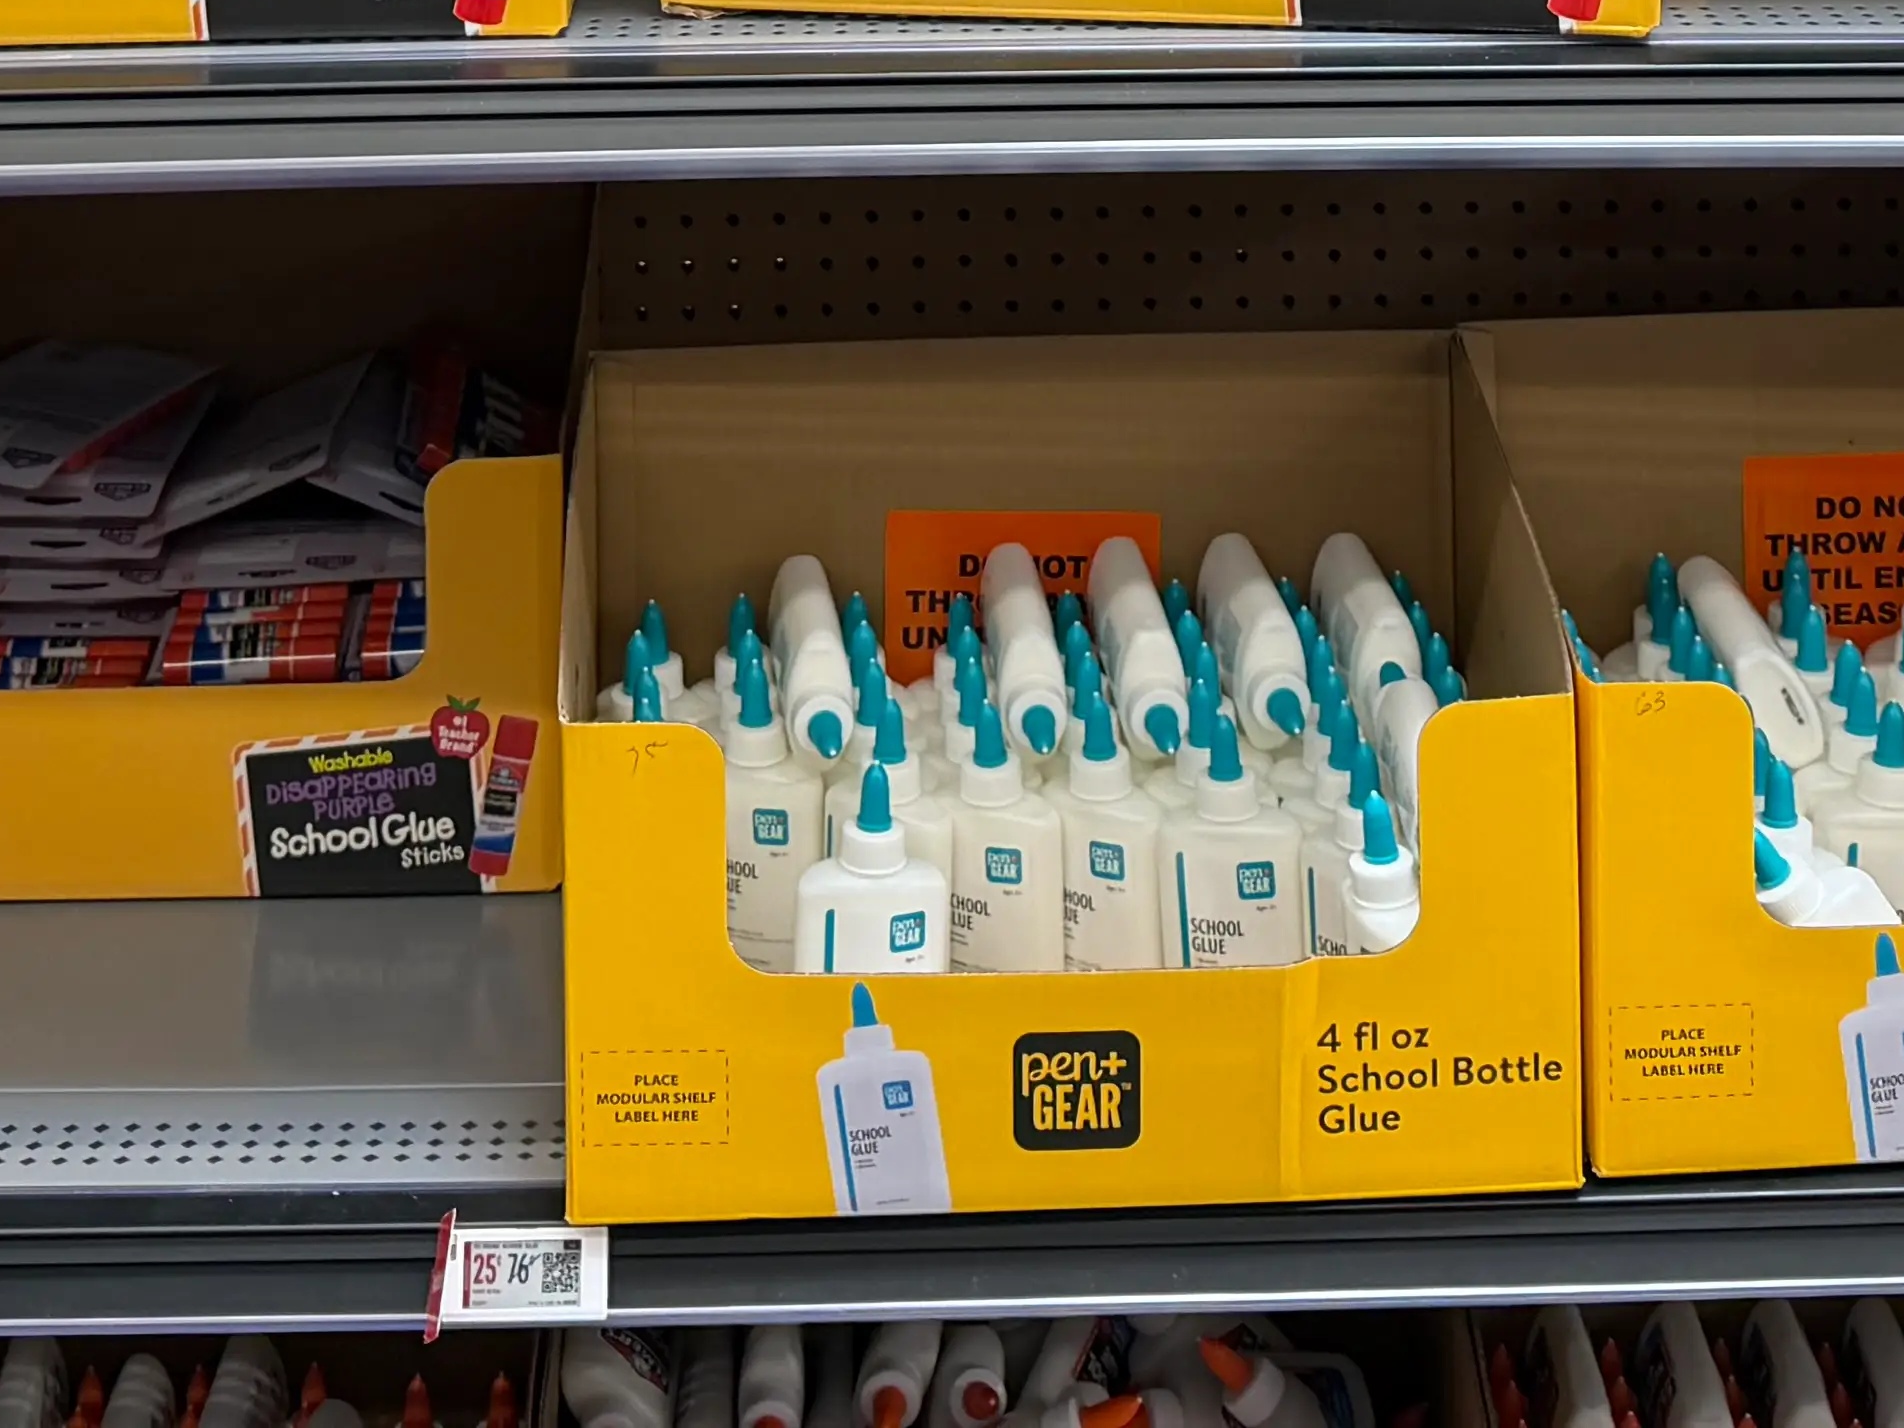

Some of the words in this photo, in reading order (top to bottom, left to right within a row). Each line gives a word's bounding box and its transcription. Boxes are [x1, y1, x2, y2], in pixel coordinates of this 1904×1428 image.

[1815, 494, 1861, 520] DO
[1765, 530, 1889, 556] THROW
[309, 748, 393, 773] Washable
[269, 816, 379, 860] School
[381, 812, 455, 848] Glue
[400, 842, 464, 870] Sticks
[1190, 918, 1245, 938] SCHOOL
[1190, 935, 1227, 955] GLUE
[633, 1074, 679, 1087] PLACE
[1316, 1061, 1439, 1096] School
[1452, 1051, 1562, 1091] Bottle
[1033, 1082, 1122, 1132] GEAR
